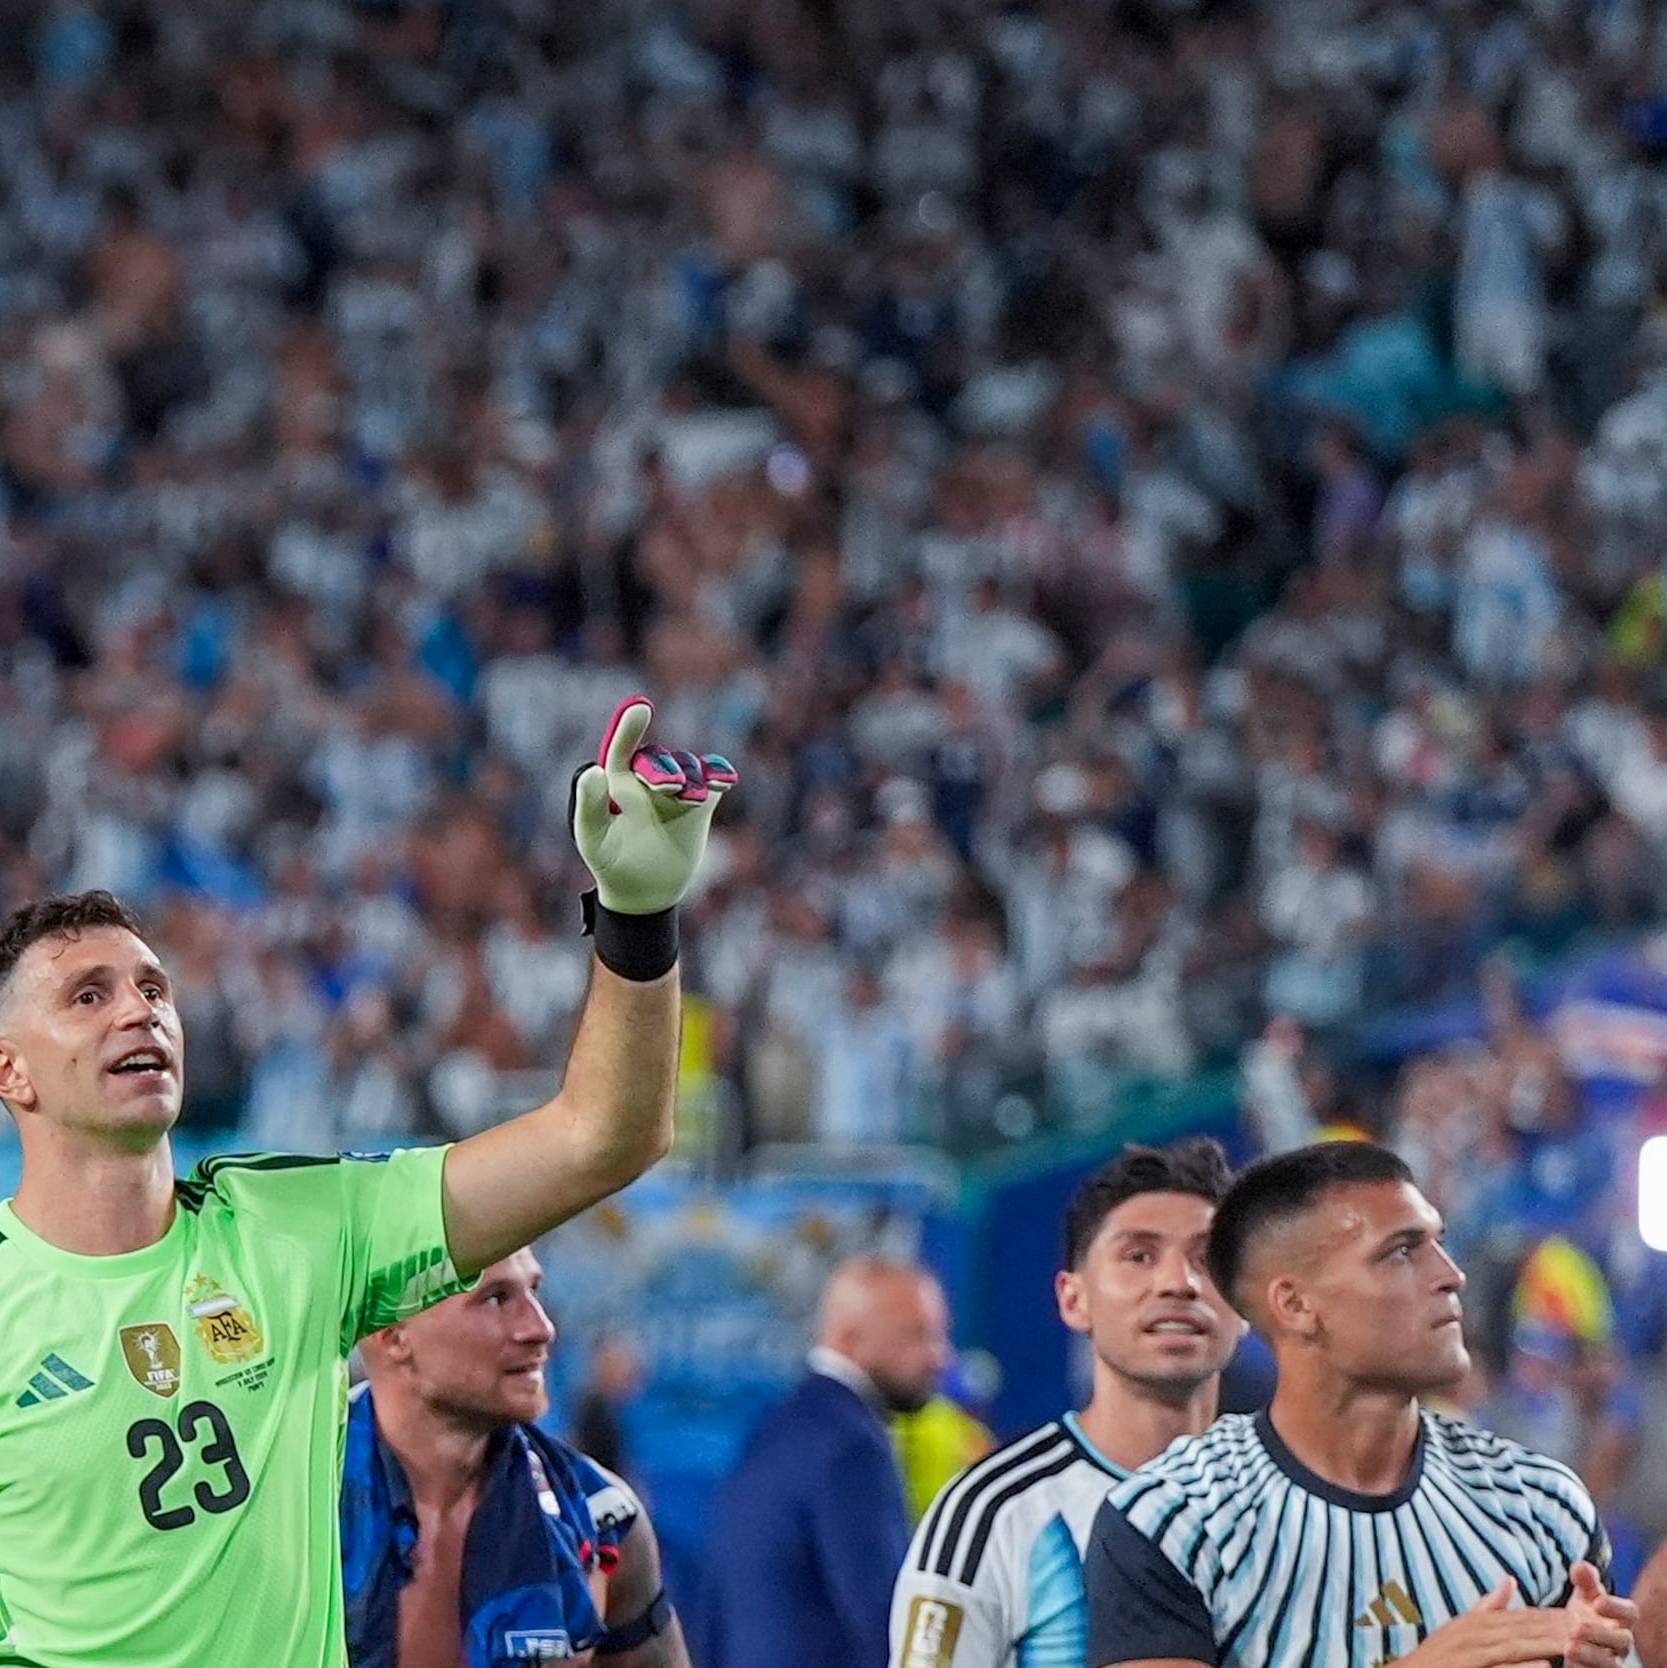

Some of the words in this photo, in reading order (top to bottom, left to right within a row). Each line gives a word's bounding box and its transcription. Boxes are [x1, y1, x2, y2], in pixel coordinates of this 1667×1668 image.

[206, 1311, 247, 1343] AFA
[147, 1369, 175, 1381] FIFA
[126, 1400, 250, 1531] 23
